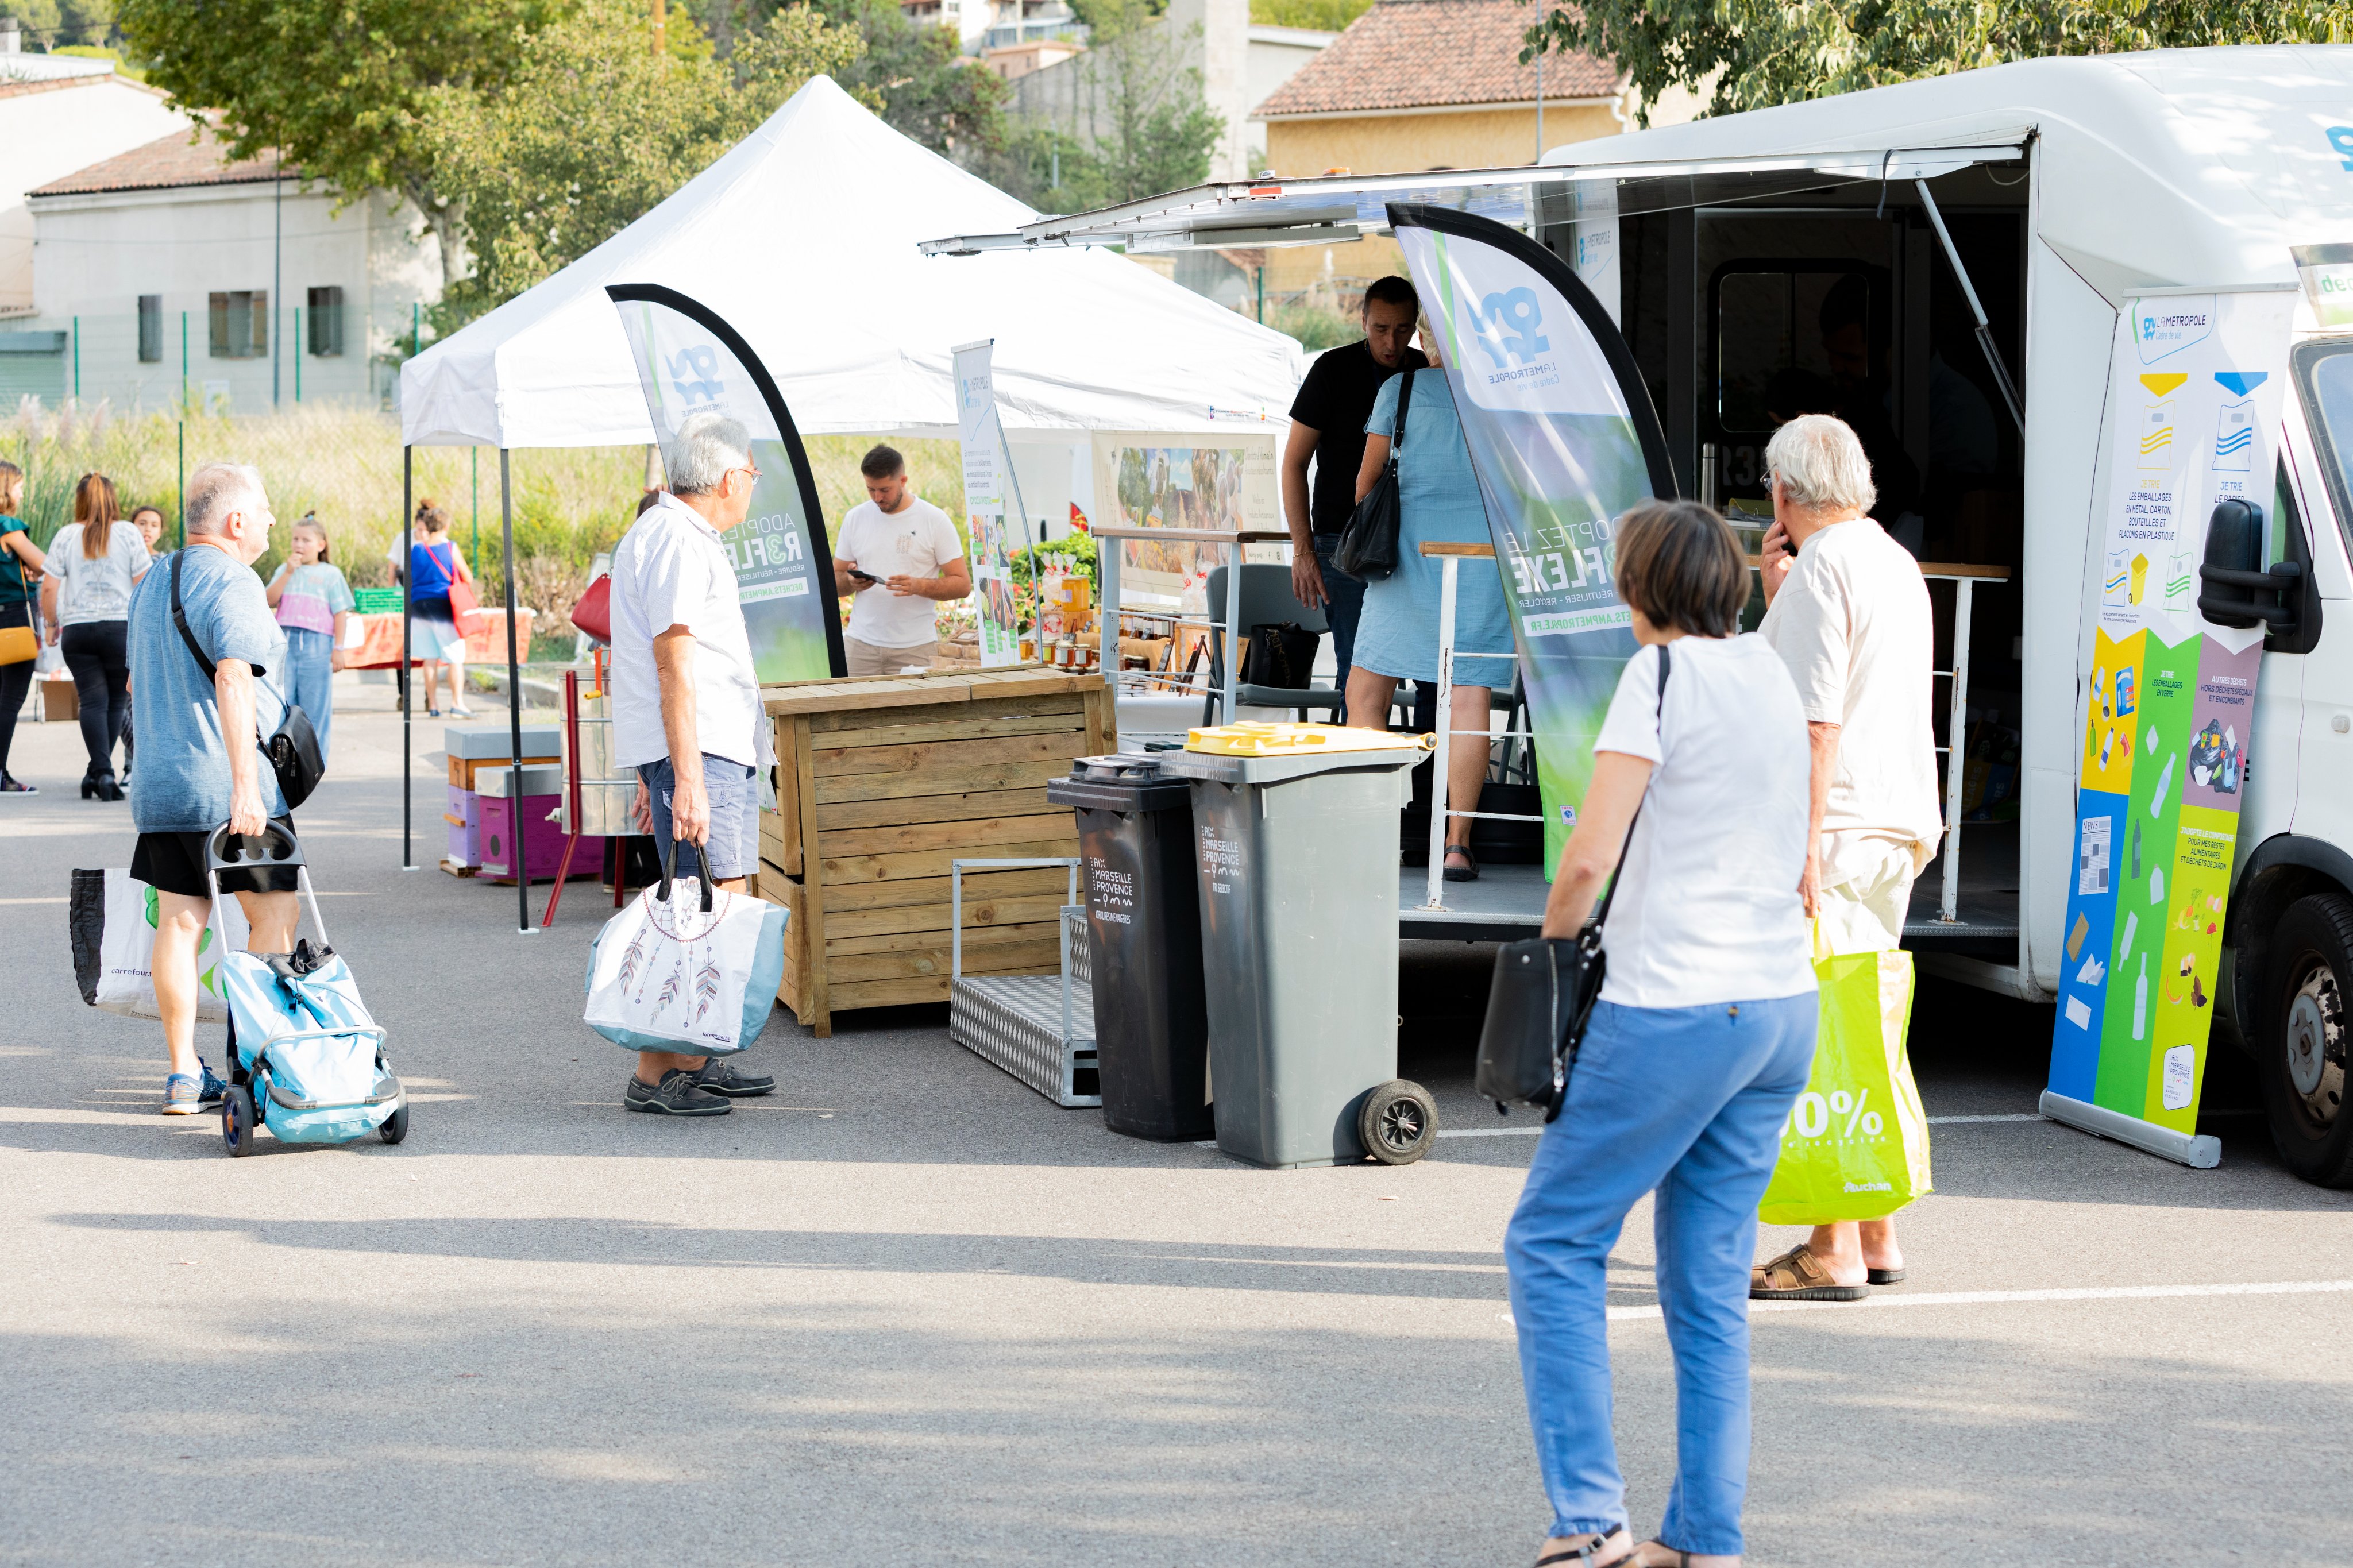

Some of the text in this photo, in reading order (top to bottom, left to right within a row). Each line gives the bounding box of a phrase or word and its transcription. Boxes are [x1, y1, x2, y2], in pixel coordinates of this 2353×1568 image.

[2155, 330, 2168, 340] Cadre
[2169, 331, 2174, 339] de
[2141, 480, 2160, 488] JE TRIE
[2220, 482, 2242, 491] JE TRIE
[2128, 492, 2171, 501] LES EMBALLAGES
[2215, 495, 2223, 503] LE
[2126, 503, 2171, 515] EN MÉTAL, CARTON,
[2128, 517, 2166, 527] BOUTEILLES ET
[2119, 530, 2174, 541] FLACONS EN PLASTIQUE
[2165, 670, 2174, 678] TRIE
[2158, 679, 2182, 689] EMBALLAGES
[2211, 675, 2247, 686] AUTRES DÉCHETS
[2162, 689, 2174, 698] VERRE
[2201, 685, 2252, 697] HORS DÉCHETS SPÉCIAUX
[2216, 696, 2244, 706] ENCOMBRANTS
[2202, 829, 2208, 838] LE
[2208, 829, 2234, 843] COMPOSTAGE
[2188, 837, 2225, 850] POUR MES RESTES
[1206, 851, 1239, 866] PROVENCE
[2190, 848, 2220, 860] ALIMENTAIRES
[2186, 856, 2206, 867] DÉCHETS
[2207, 860, 2213, 868] DE
[2213, 861, 2227, 870] JARDIN
[1096, 881, 1133, 896] PROVENCE
[1217, 883, 1231, 894] SELECTIF
[1096, 910, 1131, 924] ORDURES MENAGERES
[2170, 1068, 2189, 1079] PROVENCE
[1843, 1181, 1892, 1193] Auchan
